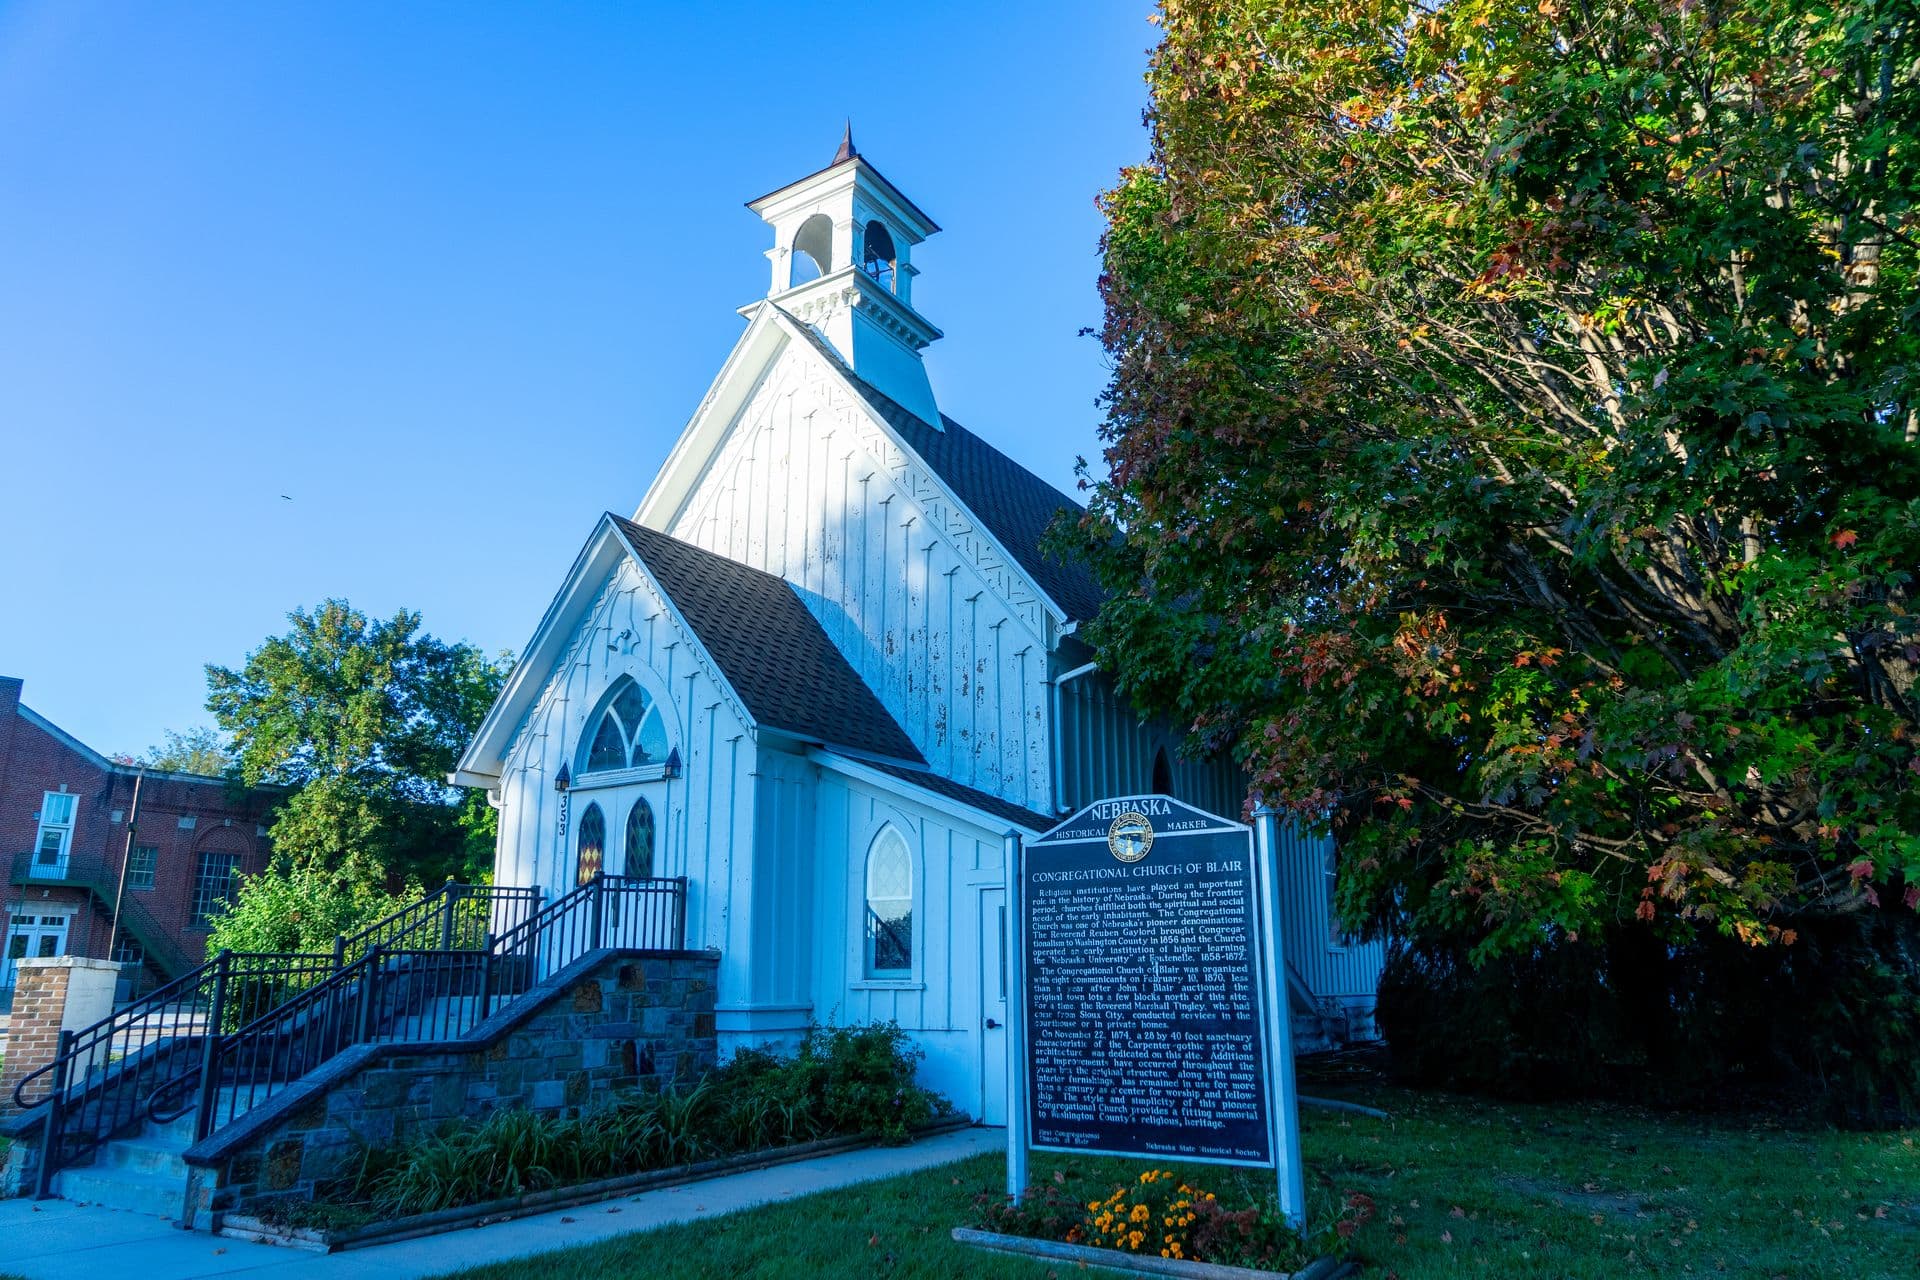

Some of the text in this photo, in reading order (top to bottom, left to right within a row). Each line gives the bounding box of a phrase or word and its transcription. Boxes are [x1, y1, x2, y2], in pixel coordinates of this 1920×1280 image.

[559, 796, 568, 836] 353
[1092, 800, 1172, 820] NEBRASKA
[1056, 820, 1208, 838] HISTORICAL MARKER
[1032, 861, 1241, 882] CONGREGATIONAL CHURCH OF BLAIR
[1076, 886, 1121, 894] institutions
[1150, 882, 1179, 892] played
[1198, 879, 1243, 889] important
[1072, 895, 1100, 903] history
[1158, 891, 1187, 900] During
[1207, 888, 1243, 897] frontier
[1060, 904, 1092, 912] churches
[1094, 902, 1125, 910] fulfilled
[1127, 901, 1146, 909] both
[1164, 899, 1198, 909] spiritual
[1201, 898, 1216, 906] and
[1219, 897, 1243, 905] social
[1080, 912, 1099, 921] early
[1177, 906, 1244, 917] Congregational
[1032, 922, 1058, 930] Church
[1102, 919, 1143, 927] Nebraska's
[1146, 919, 1178, 928] pioneer
[1050, 929, 1085, 938] Reverend
[1122, 927, 1155, 937] Gaylord
[1160, 926, 1194, 935] brought
[1198, 925, 1244, 934] Congrega-
[1075, 938, 1116, 946] Washington
[1118, 937, 1148, 946] County
[1180, 935, 1195, 943] and
[1214, 934, 1246, 942] Church
[1032, 947, 1065, 957] operated
[1083, 946, 1104, 955] early
[1173, 944, 1201, 954] higher
[1088, 954, 1133, 964] University"
[1056, 966, 1113, 976] Congregational
[1202, 964, 1247, 974] organized
[1051, 975, 1069, 984] eight
[1143, 974, 1183, 984] February
[1181, 983, 1225, 991] auctioned
[1033, 992, 1062, 1002] original
[1212, 1002, 1230, 1010] who
[1233, 1002, 1249, 1010] had
[1132, 1010, 1175, 1018] conducted
[1236, 1011, 1250, 1019] the
[1106, 1020, 1136, 1029] private
[1156, 1031, 1167, 1041] by
[1170, 1032, 1181, 1040] 40
[1184, 1032, 1203, 1040] foot
[1205, 1033, 1252, 1043] sanctuary
[1034, 1038, 1087, 1047] characteristic
[1211, 1042, 1235, 1052] style
[1241, 1042, 1252, 1050] of
[1108, 1049, 1149, 1057] dedicated
[1165, 1050, 1181, 1058] this
[1210, 1051, 1253, 1060] Additions
[1113, 1058, 1254, 1071] have occurred throughout the
[1177, 1069, 1254, 1081] along with many
[1121, 1076, 1135, 1085] has
[1139, 1078, 1178, 1087] remained
[1213, 1080, 1228, 1088] for
[1148, 1087, 1161, 1095] for
[1165, 1088, 1200, 1099] worship
[1204, 1090, 1220, 1098] and
[1224, 1090, 1256, 1099] fellow-
[1082, 1094, 1256, 1109] style and simplicity of this pioneer
[1037, 1100, 1258, 1120] Congregational Church provides fitting memorial
[1184, 1117, 1225, 1129] heritage.
